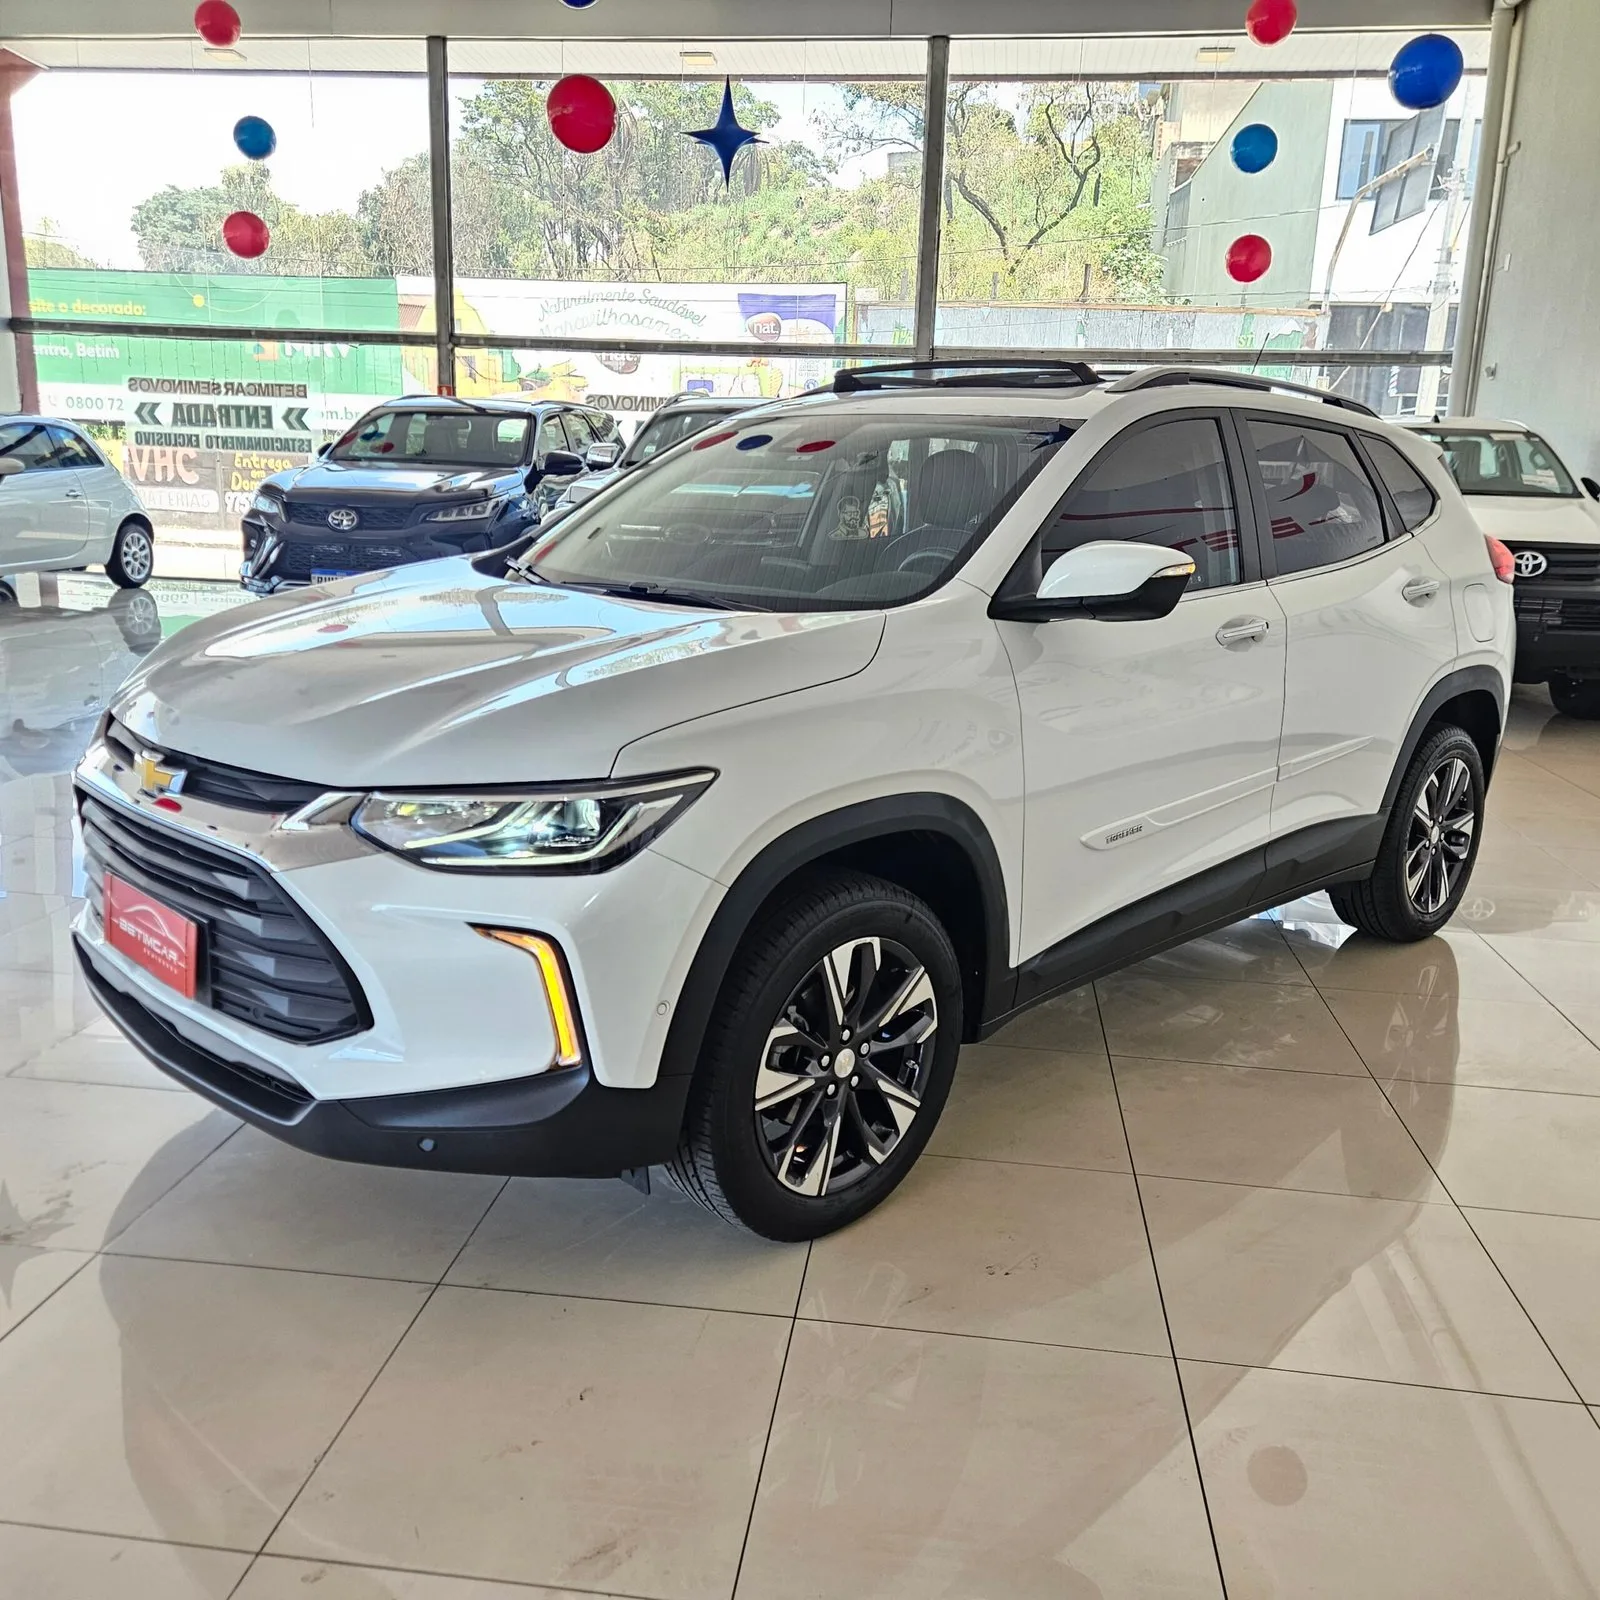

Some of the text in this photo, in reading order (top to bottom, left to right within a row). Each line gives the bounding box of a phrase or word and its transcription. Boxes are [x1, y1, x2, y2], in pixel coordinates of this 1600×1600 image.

[58, 301, 69, 313] o
[71, 298, 147, 316] decorado:
[538, 287, 708, 327] Naturalmente Saudável
[752, 322, 780, 335] nat.
[75, 343, 120, 359] Betim
[65, 395, 104, 411] 0800
[234, 450, 293, 473] Entrega
